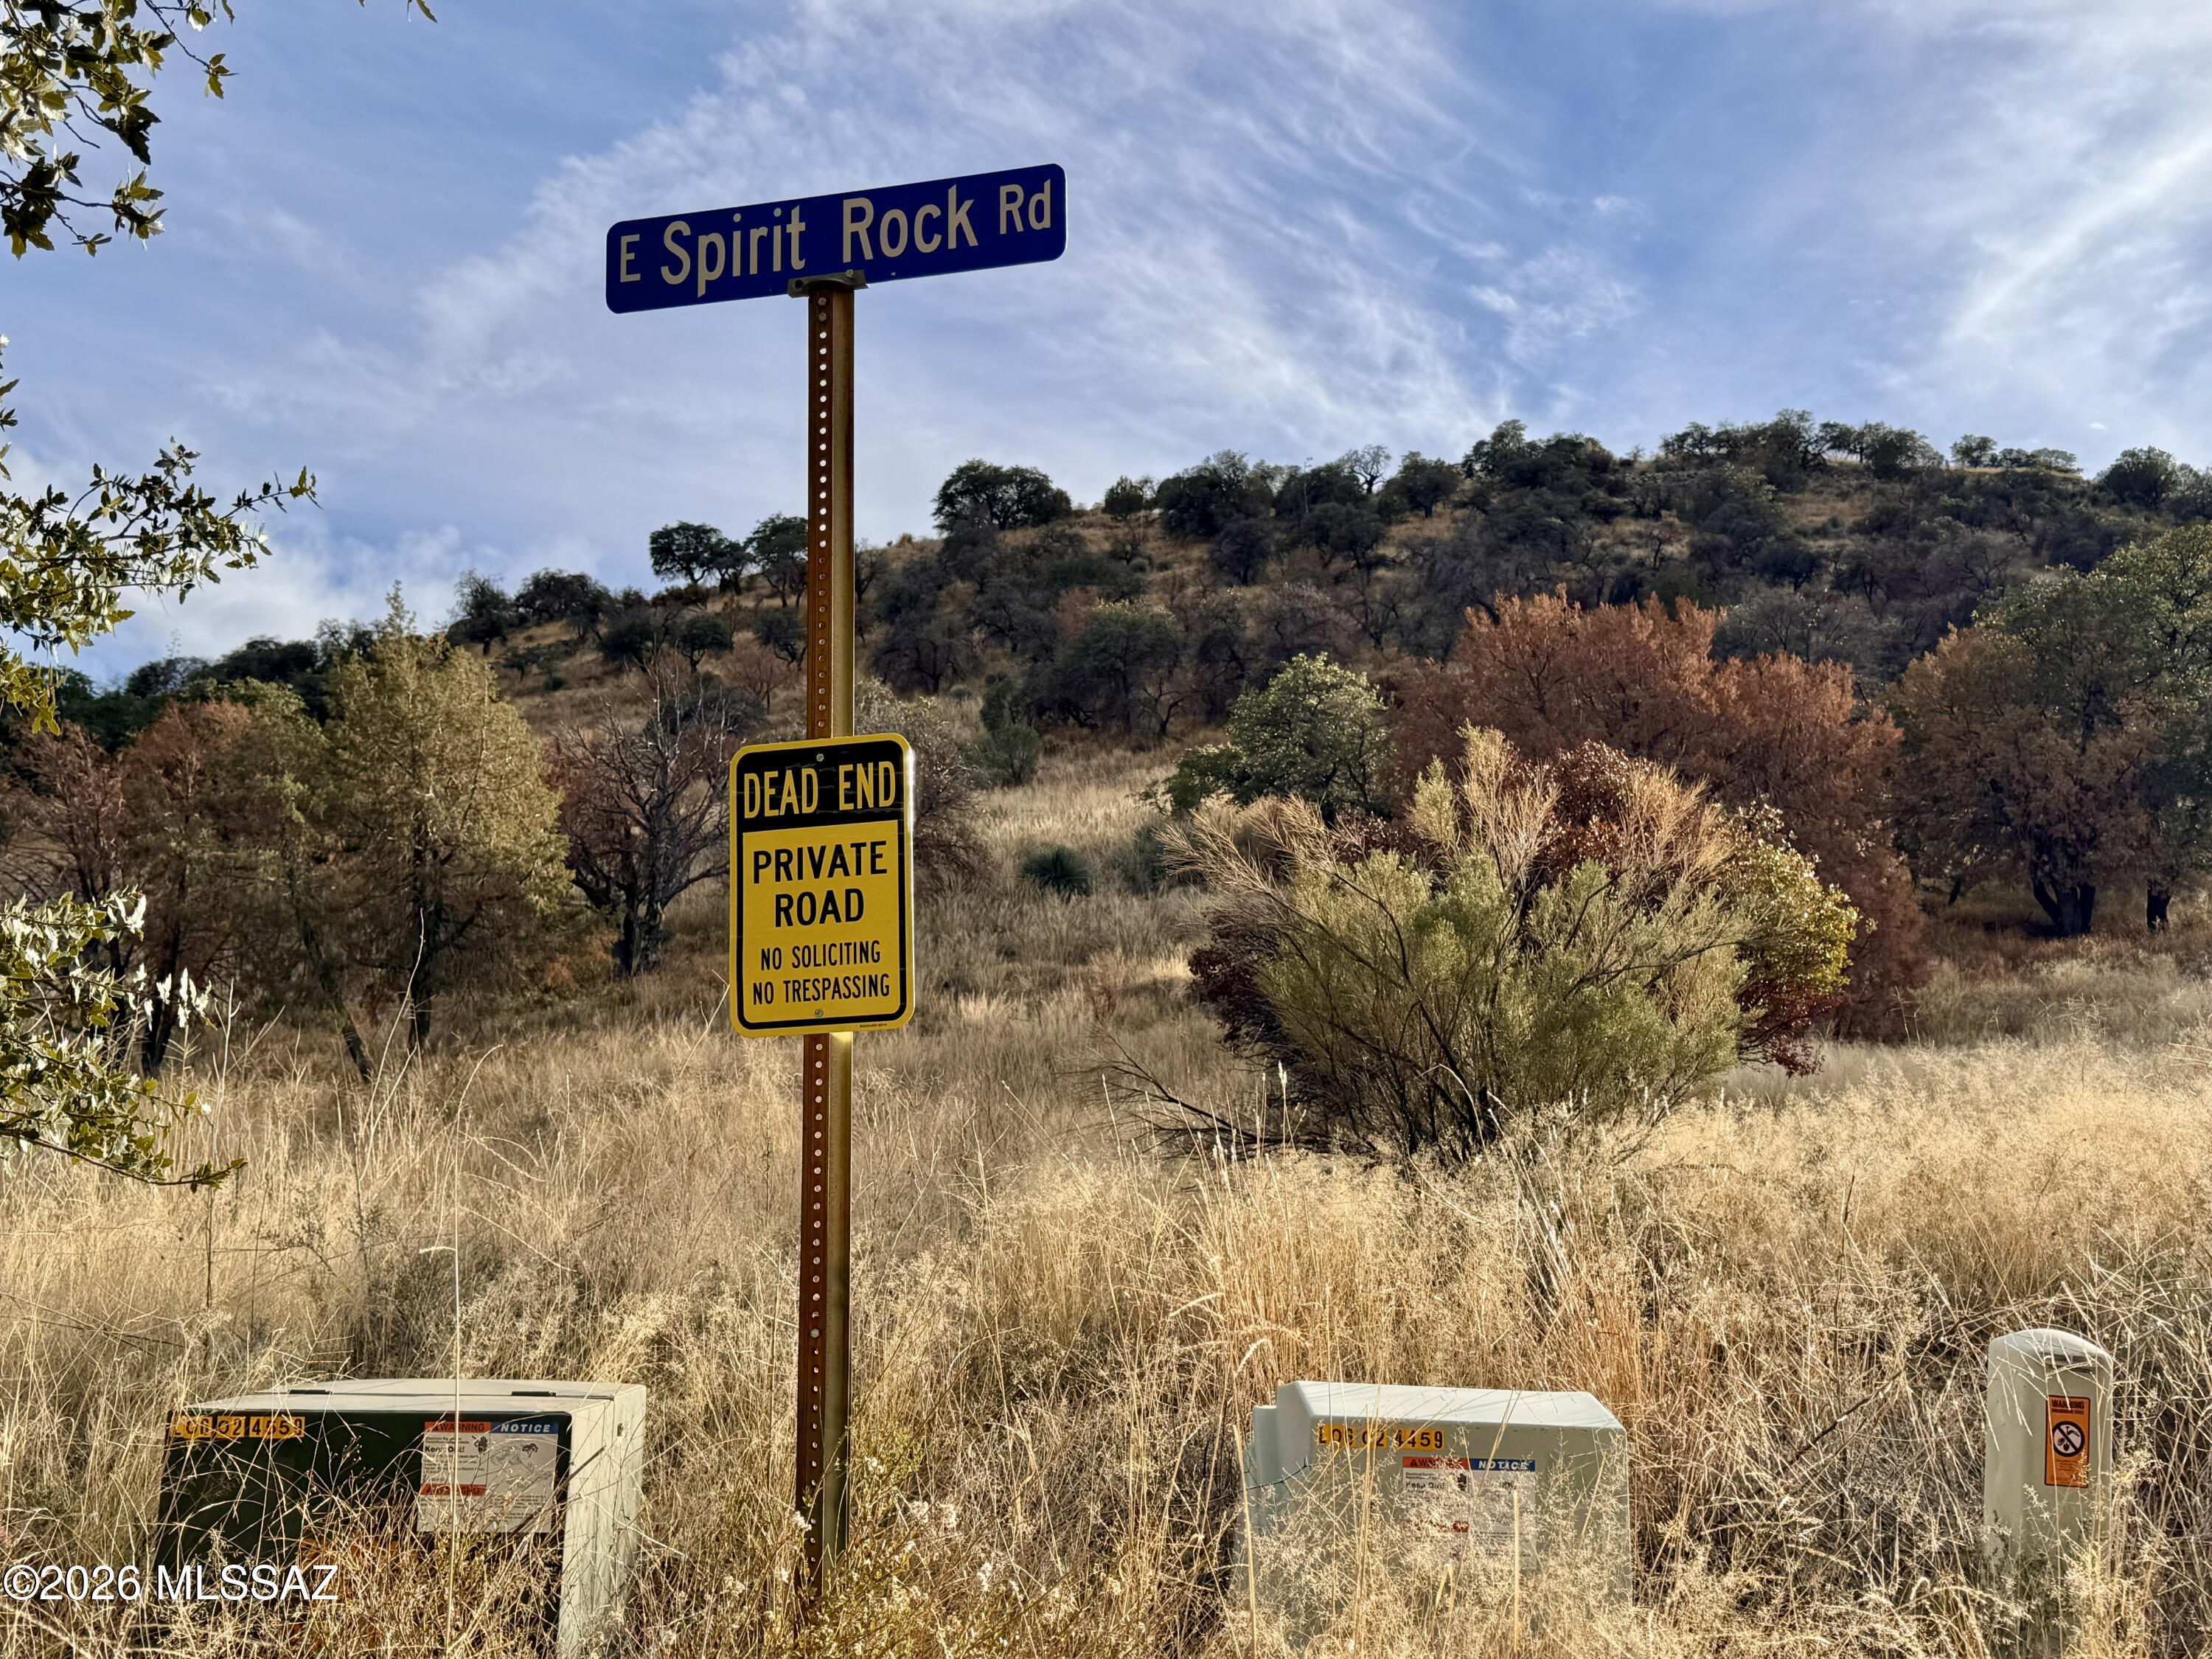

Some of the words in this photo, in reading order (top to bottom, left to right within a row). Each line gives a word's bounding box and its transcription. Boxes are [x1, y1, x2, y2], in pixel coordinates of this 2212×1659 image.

[620, 234, 641, 283] E
[661, 204, 806, 298] Spirit
[842, 184, 978, 263] Rock
[999, 178, 1051, 235] Rd
[744, 768, 818, 818] DEAD
[838, 761, 896, 811] END
[754, 841, 888, 884] PRIVATE
[775, 888, 864, 928] ROAD
[761, 947, 782, 971] NO
[791, 939, 880, 969] SOLICITING
[753, 981, 774, 1005] NO
[783, 973, 890, 1003] TRESPASSING
[441, 1423, 484, 1431] WANING
[501, 1423, 551, 1433] NOTICE
[1478, 1461, 1528, 1470] NOTICE
